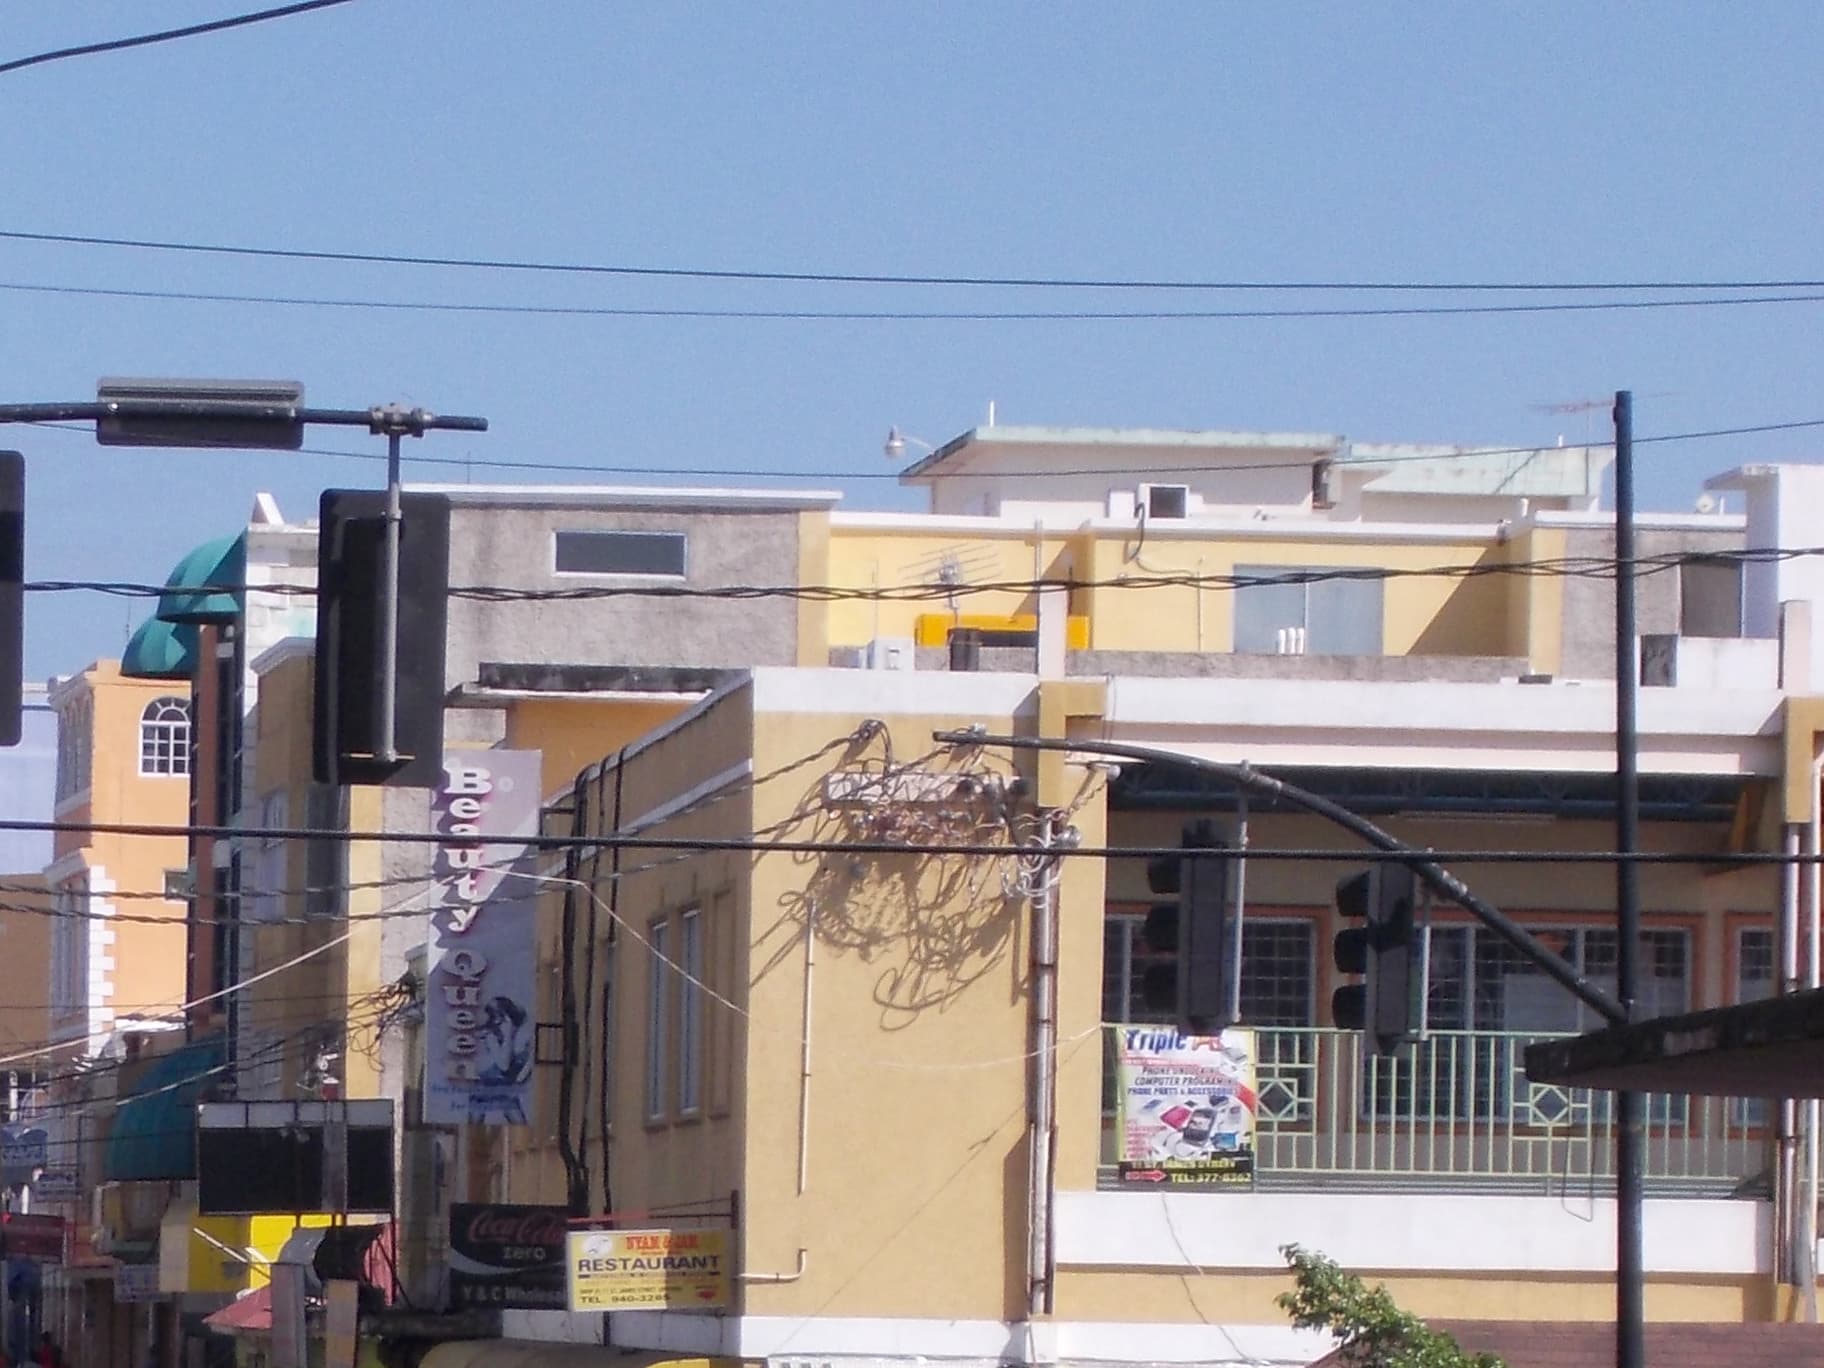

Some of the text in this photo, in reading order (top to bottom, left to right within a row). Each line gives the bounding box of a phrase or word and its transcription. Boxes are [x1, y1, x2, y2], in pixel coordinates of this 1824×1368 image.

[442, 948, 487, 1081] Queen
[1126, 1028, 1188, 1054] Triple
[1134, 1076, 1179, 1086] COMPUTER
[504, 1245, 547, 1261] zero
[578, 1254, 721, 1273] RESTAURANT
